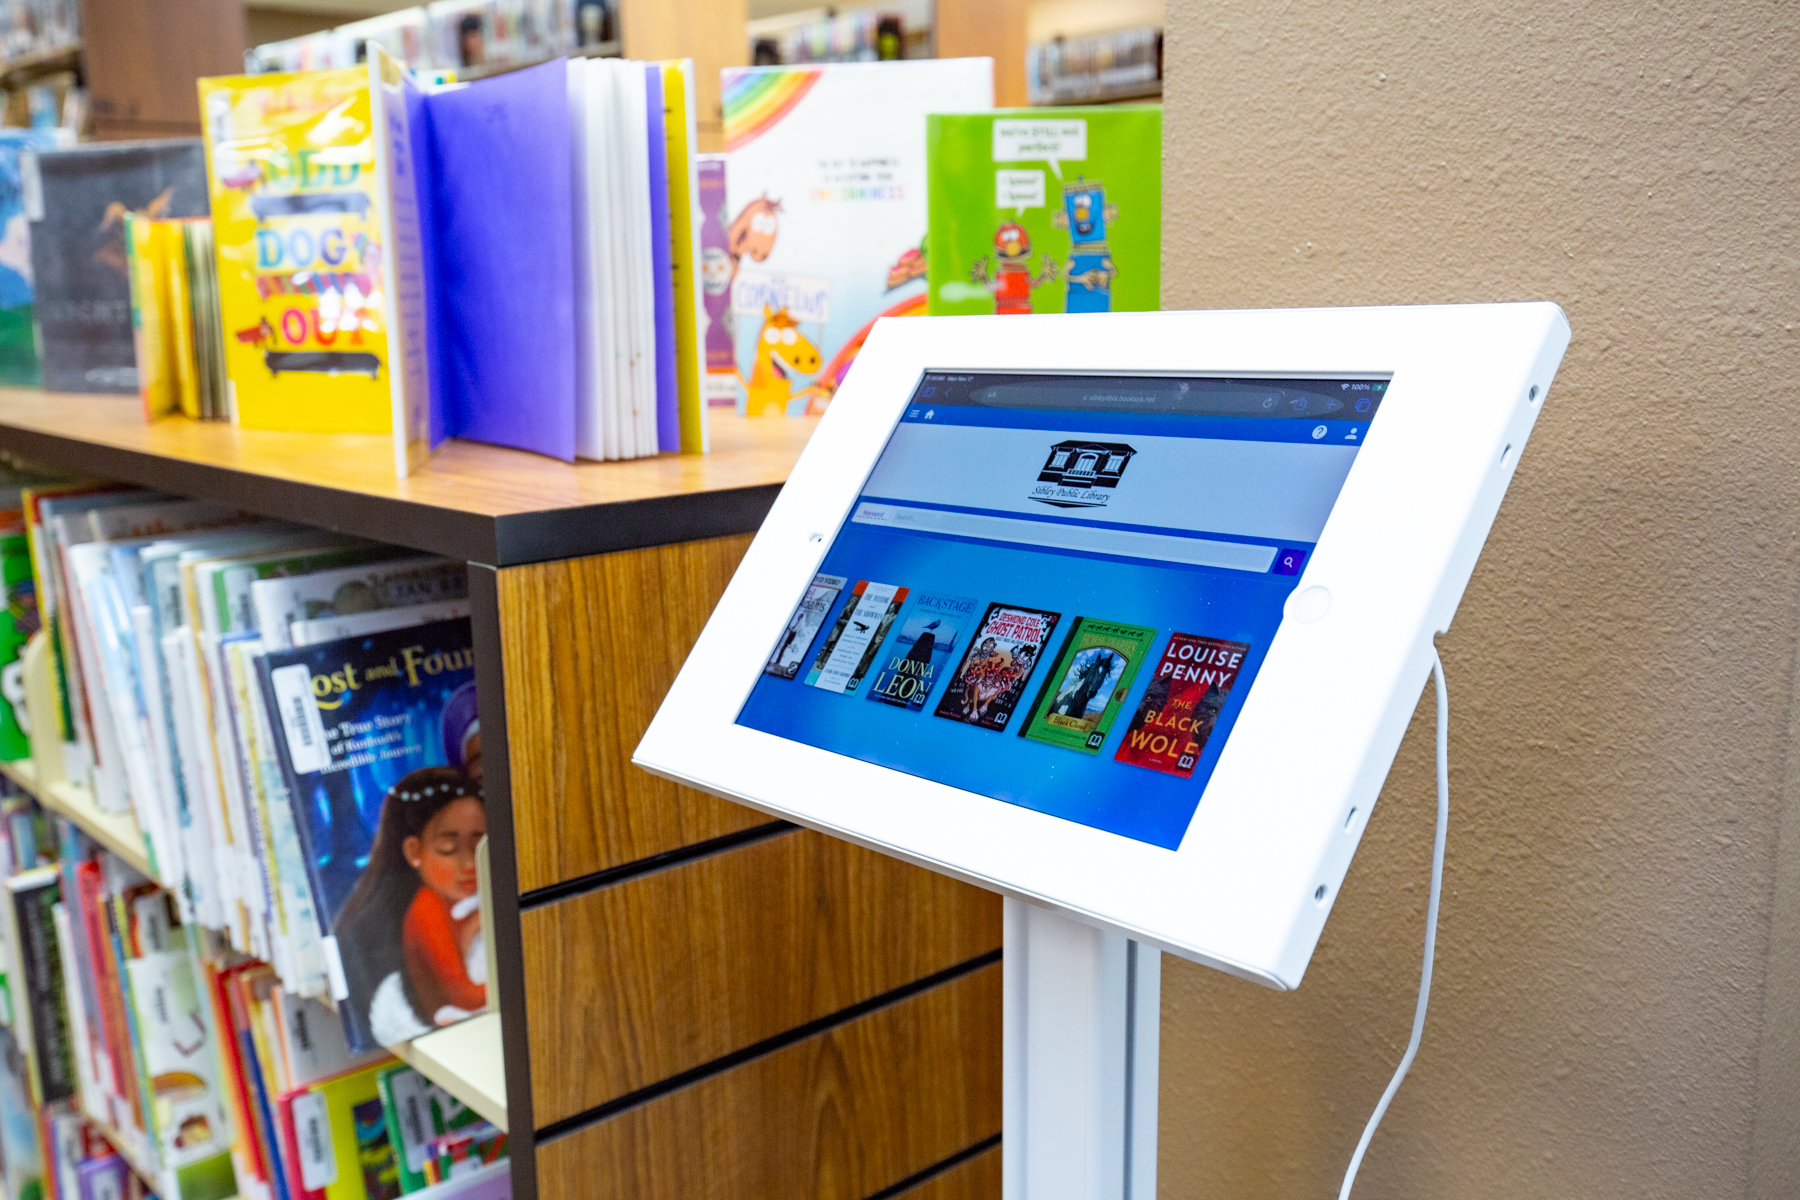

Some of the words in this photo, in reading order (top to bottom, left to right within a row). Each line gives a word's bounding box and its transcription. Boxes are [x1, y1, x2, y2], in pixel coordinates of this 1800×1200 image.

[255, 228, 347, 268] DOG
[280, 307, 367, 347] OUT
[1351, 383, 1370, 391] 100%
[1032, 485, 1055, 498] Sibley
[1057, 487, 1081, 498] Public
[1081, 490, 1110, 503] Library
[918, 594, 974, 613] BACKSTAGE
[999, 612, 1025, 625] DESMOND
[1026, 617, 1040, 627] COLE
[986, 621, 1012, 637] GHOST
[1012, 624, 1041, 642] PATROL
[1167, 642, 1242, 669] LOUISE
[311, 662, 363, 699] ost
[364, 655, 398, 682] and
[888, 656, 934, 678] DONNA
[1160, 662, 1232, 687] PENNY
[873, 672, 933, 700] LEON
[1173, 699, 1191, 710] THE
[338, 719, 373, 737] True
[1053, 715, 1069, 726] Black
[1069, 719, 1087, 729] Cloud
[1144, 710, 1204, 734] BLACK
[1131, 730, 1199, 758] WOLF
